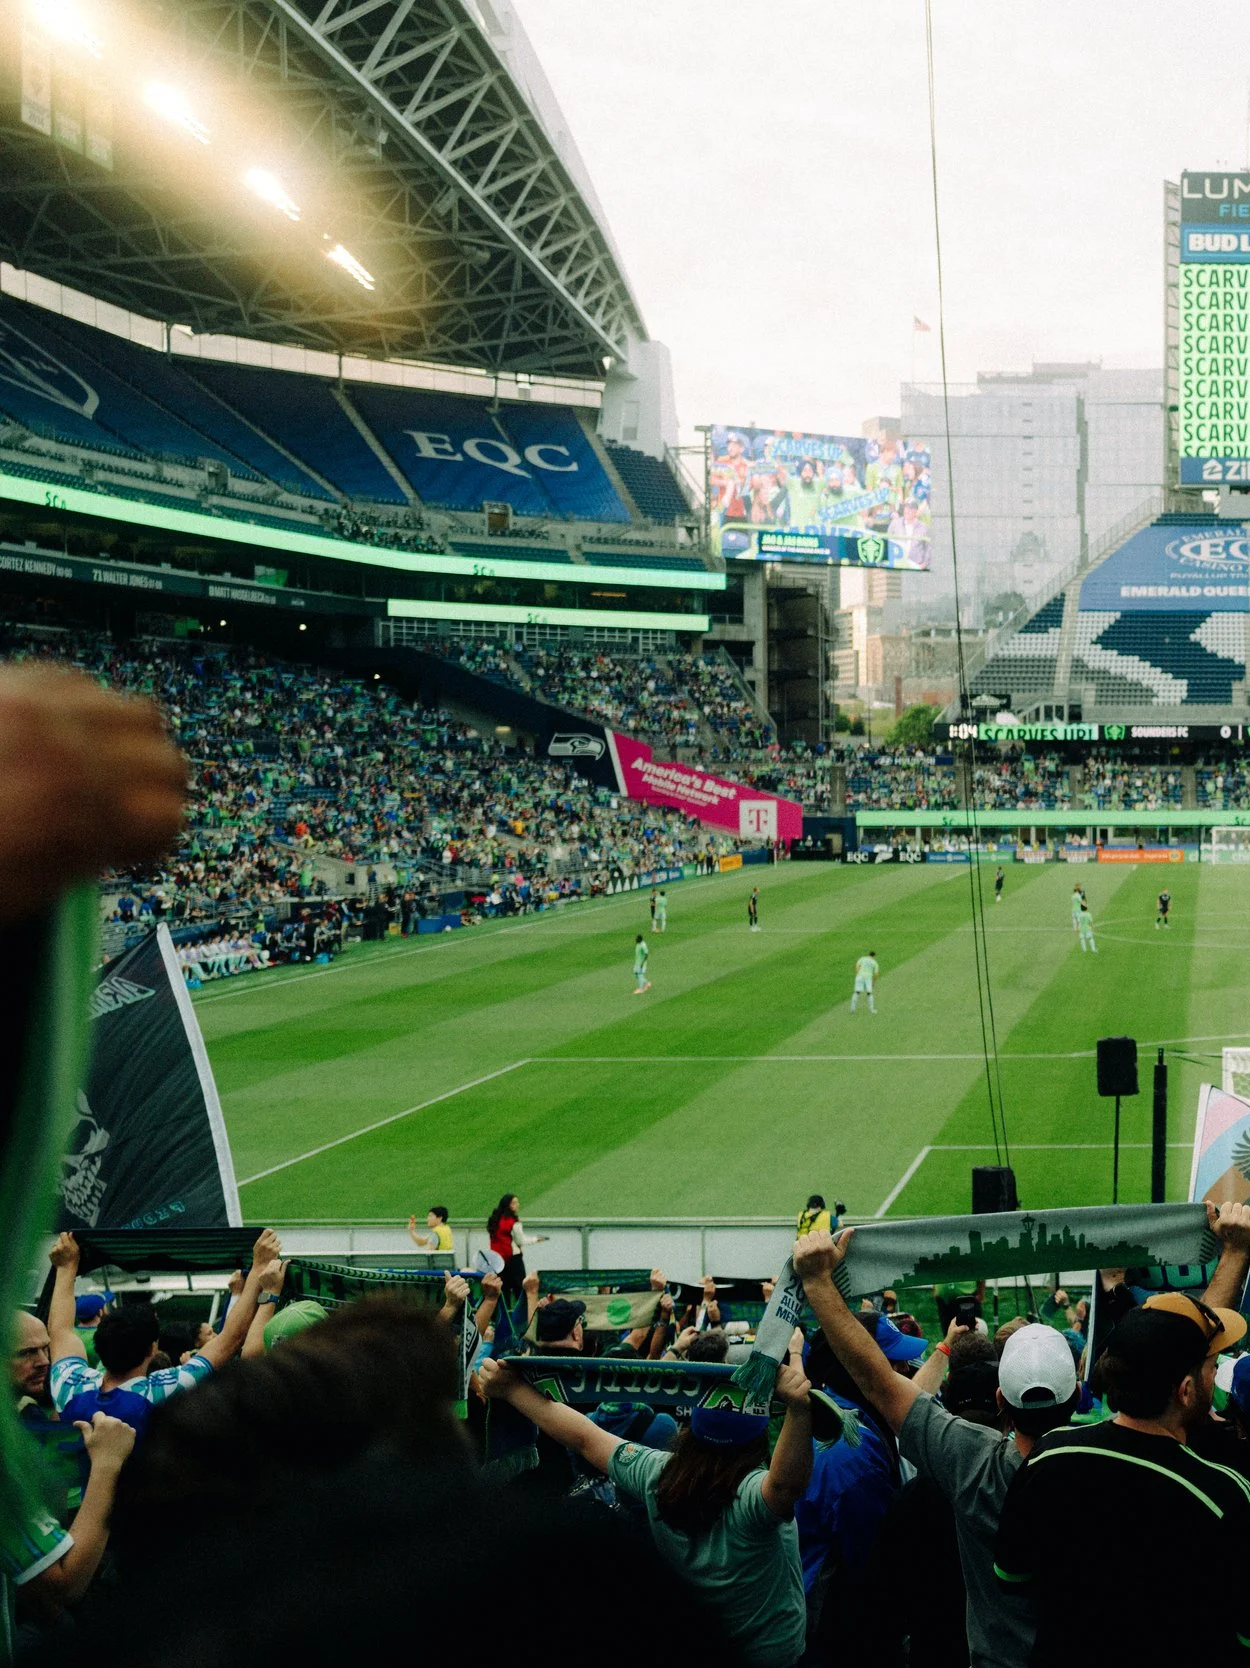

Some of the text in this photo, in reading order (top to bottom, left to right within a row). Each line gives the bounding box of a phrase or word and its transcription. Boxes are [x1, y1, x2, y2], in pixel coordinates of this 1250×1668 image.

[1188, 234, 1238, 252] BUD
[402, 430, 579, 479] EQC
[1180, 557, 1243, 573] CASINO
[1120, 585, 1201, 598] EMERALD
[1131, 727, 1176, 738] SOUNDERS
[1177, 727, 1189, 738] FC
[1220, 725, 1232, 739] 0
[631, 757, 702, 790] America's
[703, 778, 737, 800] Best
[641, 772, 677, 793] Mobile
[677, 784, 720, 806] Network
[846, 851, 869, 864] EQC
